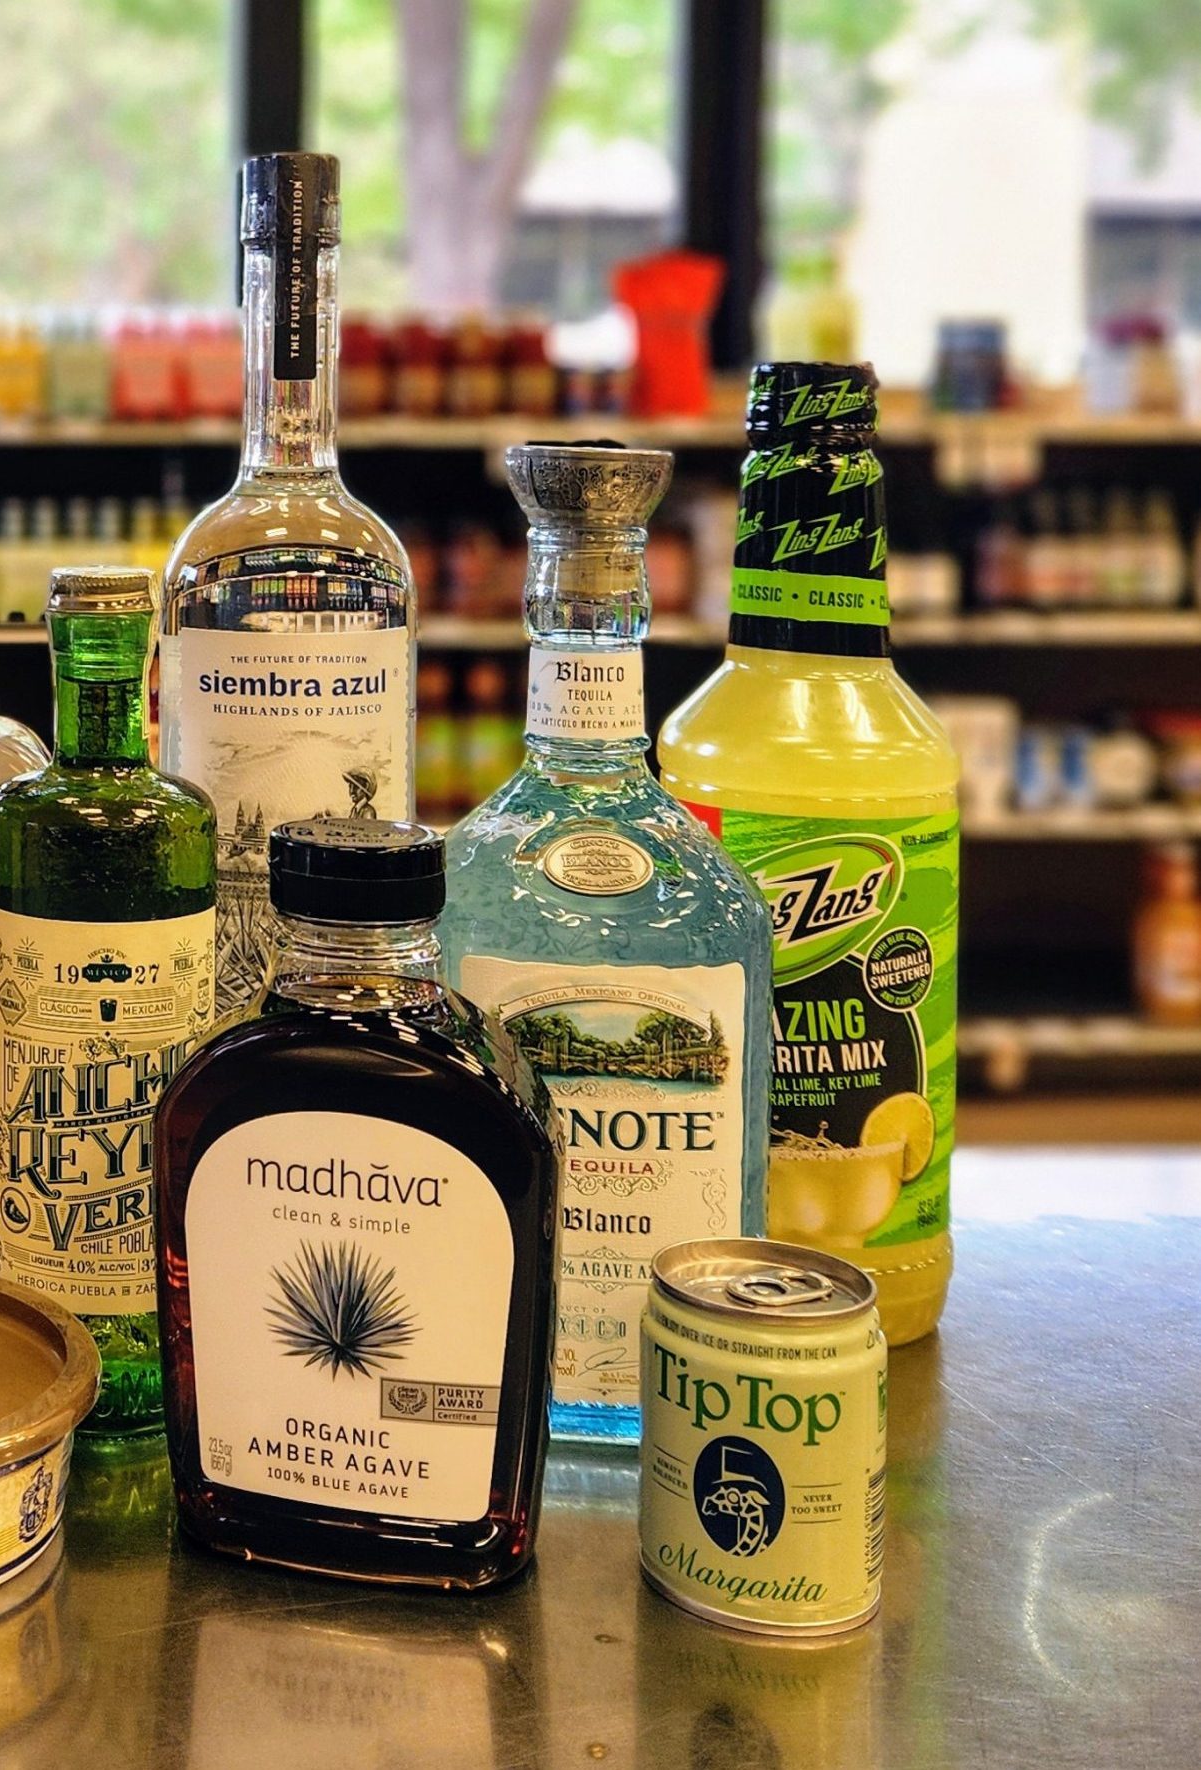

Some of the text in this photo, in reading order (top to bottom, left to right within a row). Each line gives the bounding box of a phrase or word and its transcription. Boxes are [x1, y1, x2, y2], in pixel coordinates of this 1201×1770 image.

[290, 180, 303, 358] THE FUTURE OF TRADITION
[738, 584, 782, 602] CLASSIC
[809, 590, 865, 608] CLASSIC
[200, 669, 386, 697] siembra azul
[556, 661, 625, 683] Blanco
[567, 689, 612, 701] TEQUILA
[213, 704, 382, 716] HIGHLANDS OF JALISCO
[560, 706, 615, 715] AGAVE
[871, 949, 927, 974] NATURALLY
[54, 963, 159, 985] 19 27
[870, 963, 930, 989] SWEETENED
[123, 1001, 173, 1015] MEXICANO
[522, 988, 687, 1012] TEQUILA MEXICANO ORIGINAL
[4, 1037, 67, 1064] MENJURJE
[841, 1040, 887, 1072] MIX
[828, 1076, 851, 1090] KEY
[854, 1073, 881, 1088] LIME
[769, 1093, 836, 1106] RAPEFRUIT
[569, 1159, 655, 1175] EQUILA
[272, 1205, 411, 1235] clean & simple
[563, 1207, 651, 1234] Blanco
[81, 1239, 113, 1254] CHILE
[31, 1255, 135, 1274] LIQUEUR 40% ALC/VOL
[581, 1263, 632, 1278] AGAVE
[17, 1273, 116, 1296] HEROICA PUEBLA
[681, 1325, 837, 1360] OVER ICE OR STRAIGHT FROM THE CAN
[438, 1388, 484, 1399] PURITY
[438, 1398, 483, 1409] AWARD
[654, 1343, 841, 1446] Tip Top
[438, 1412, 477, 1421] Certified
[285, 1417, 391, 1449] ORGANIC
[248, 1436, 430, 1480] AMBER AGAVE
[267, 1466, 409, 1499] 100% BLUE AGAVE
[791, 1503, 843, 1515] TOO SWEET
[803, 1494, 832, 1503] NEVER
[659, 1542, 828, 1603] Margarita
